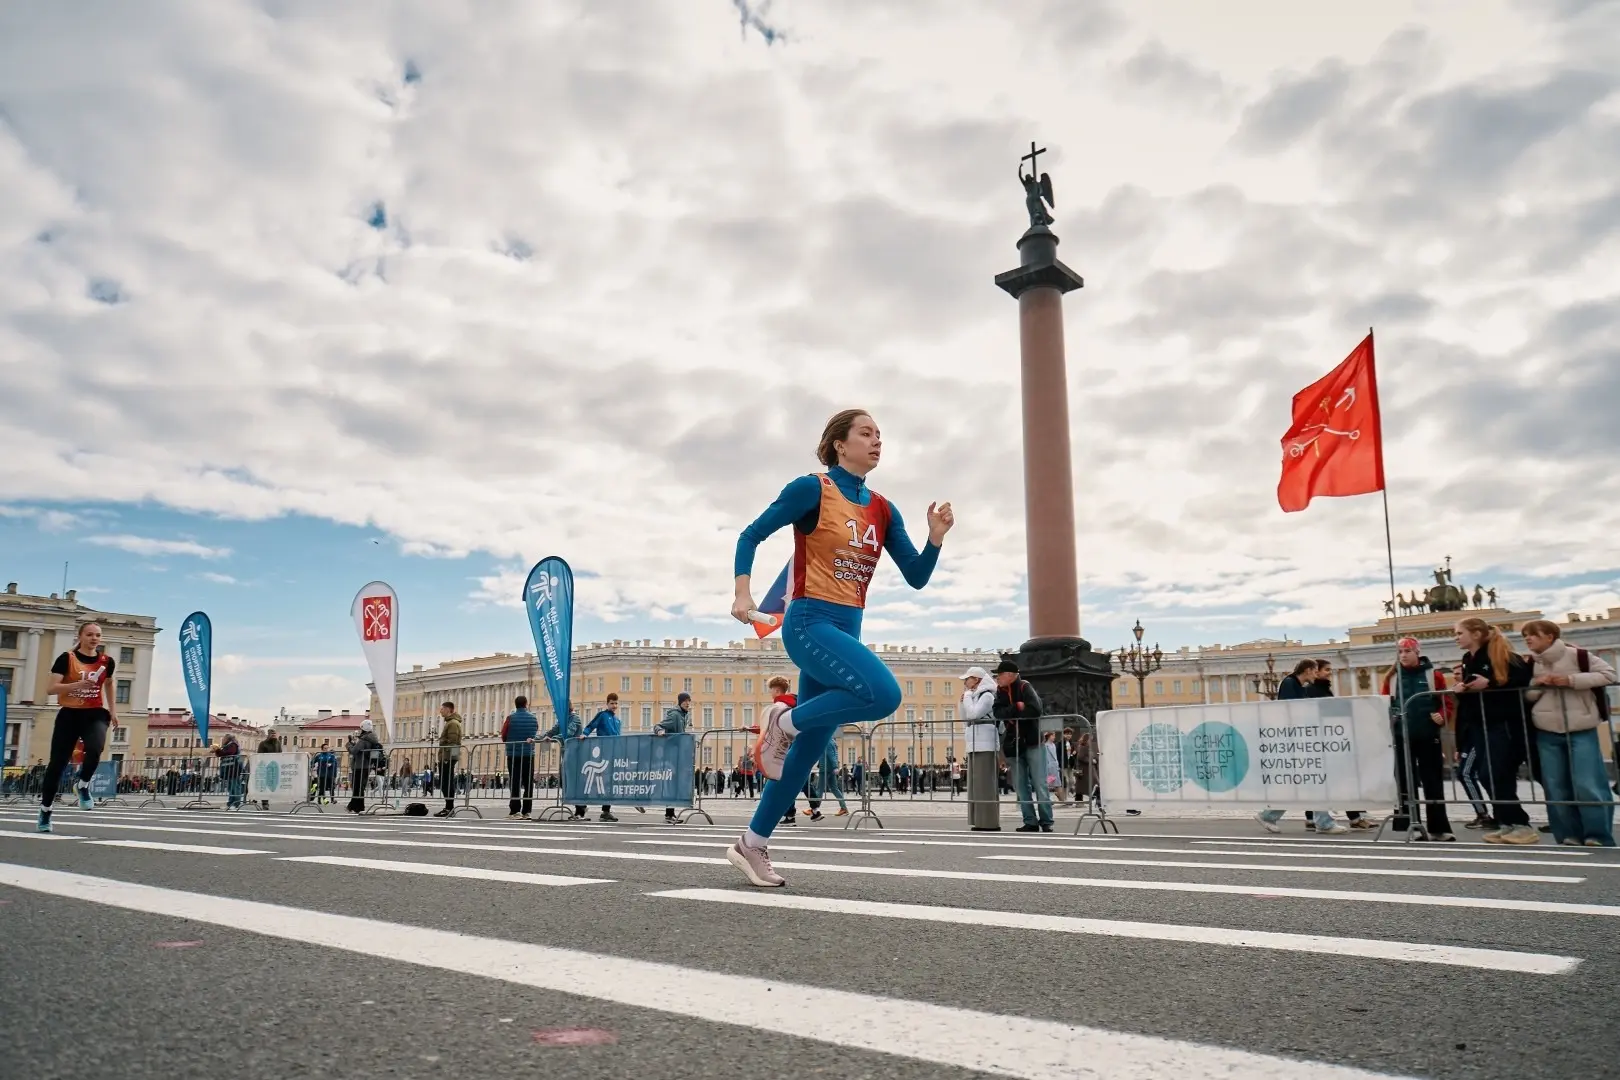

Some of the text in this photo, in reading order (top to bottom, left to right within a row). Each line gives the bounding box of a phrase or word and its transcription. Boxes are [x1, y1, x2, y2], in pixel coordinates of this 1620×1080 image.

[845, 519, 879, 552] 14
[549, 606, 560, 625] МЫ
[190, 647, 206, 692] СПОРТИВНЫЙ
[1259, 725, 1345, 738] КОМИТЕТ ПО
[1259, 738, 1351, 754] ФИЗИЧЕСКОЙ
[613, 758, 629, 768] МЫ
[1260, 758, 1322, 769] КУЛЬТУРЕ
[1262, 773, 1327, 785] И СПОРТУ
